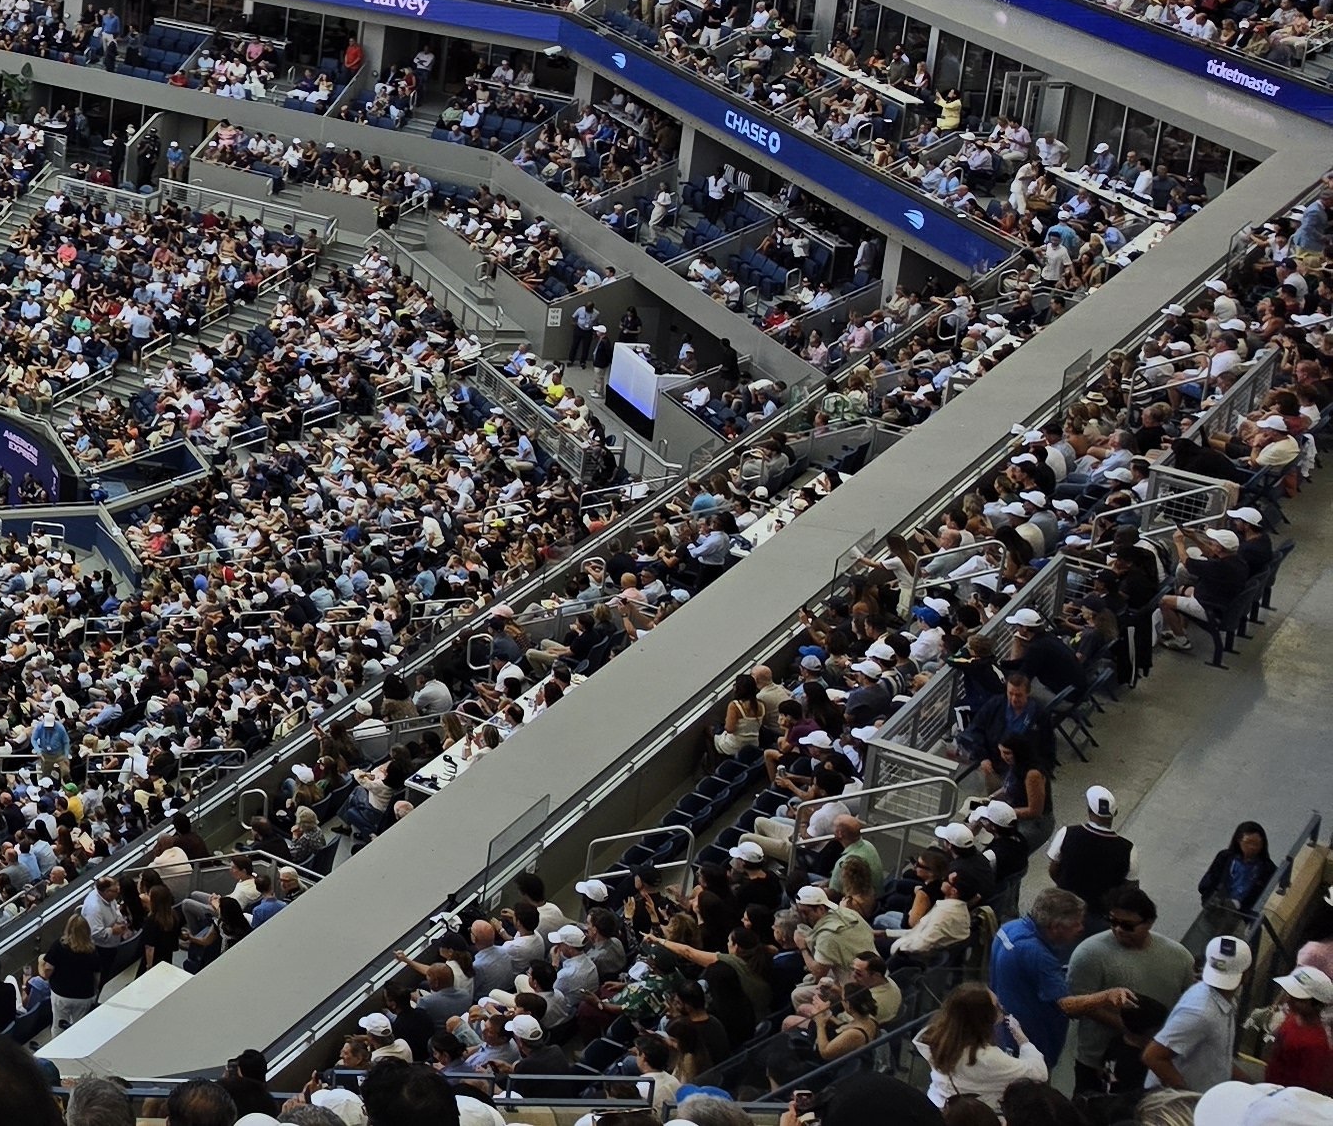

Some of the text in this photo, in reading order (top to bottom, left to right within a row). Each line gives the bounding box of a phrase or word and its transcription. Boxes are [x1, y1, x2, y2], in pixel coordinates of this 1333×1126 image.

[1206, 59, 1281, 97] ticketmaster
[724, 109, 769, 147] CHASE
[3, 430, 38, 457] AMERICAN
